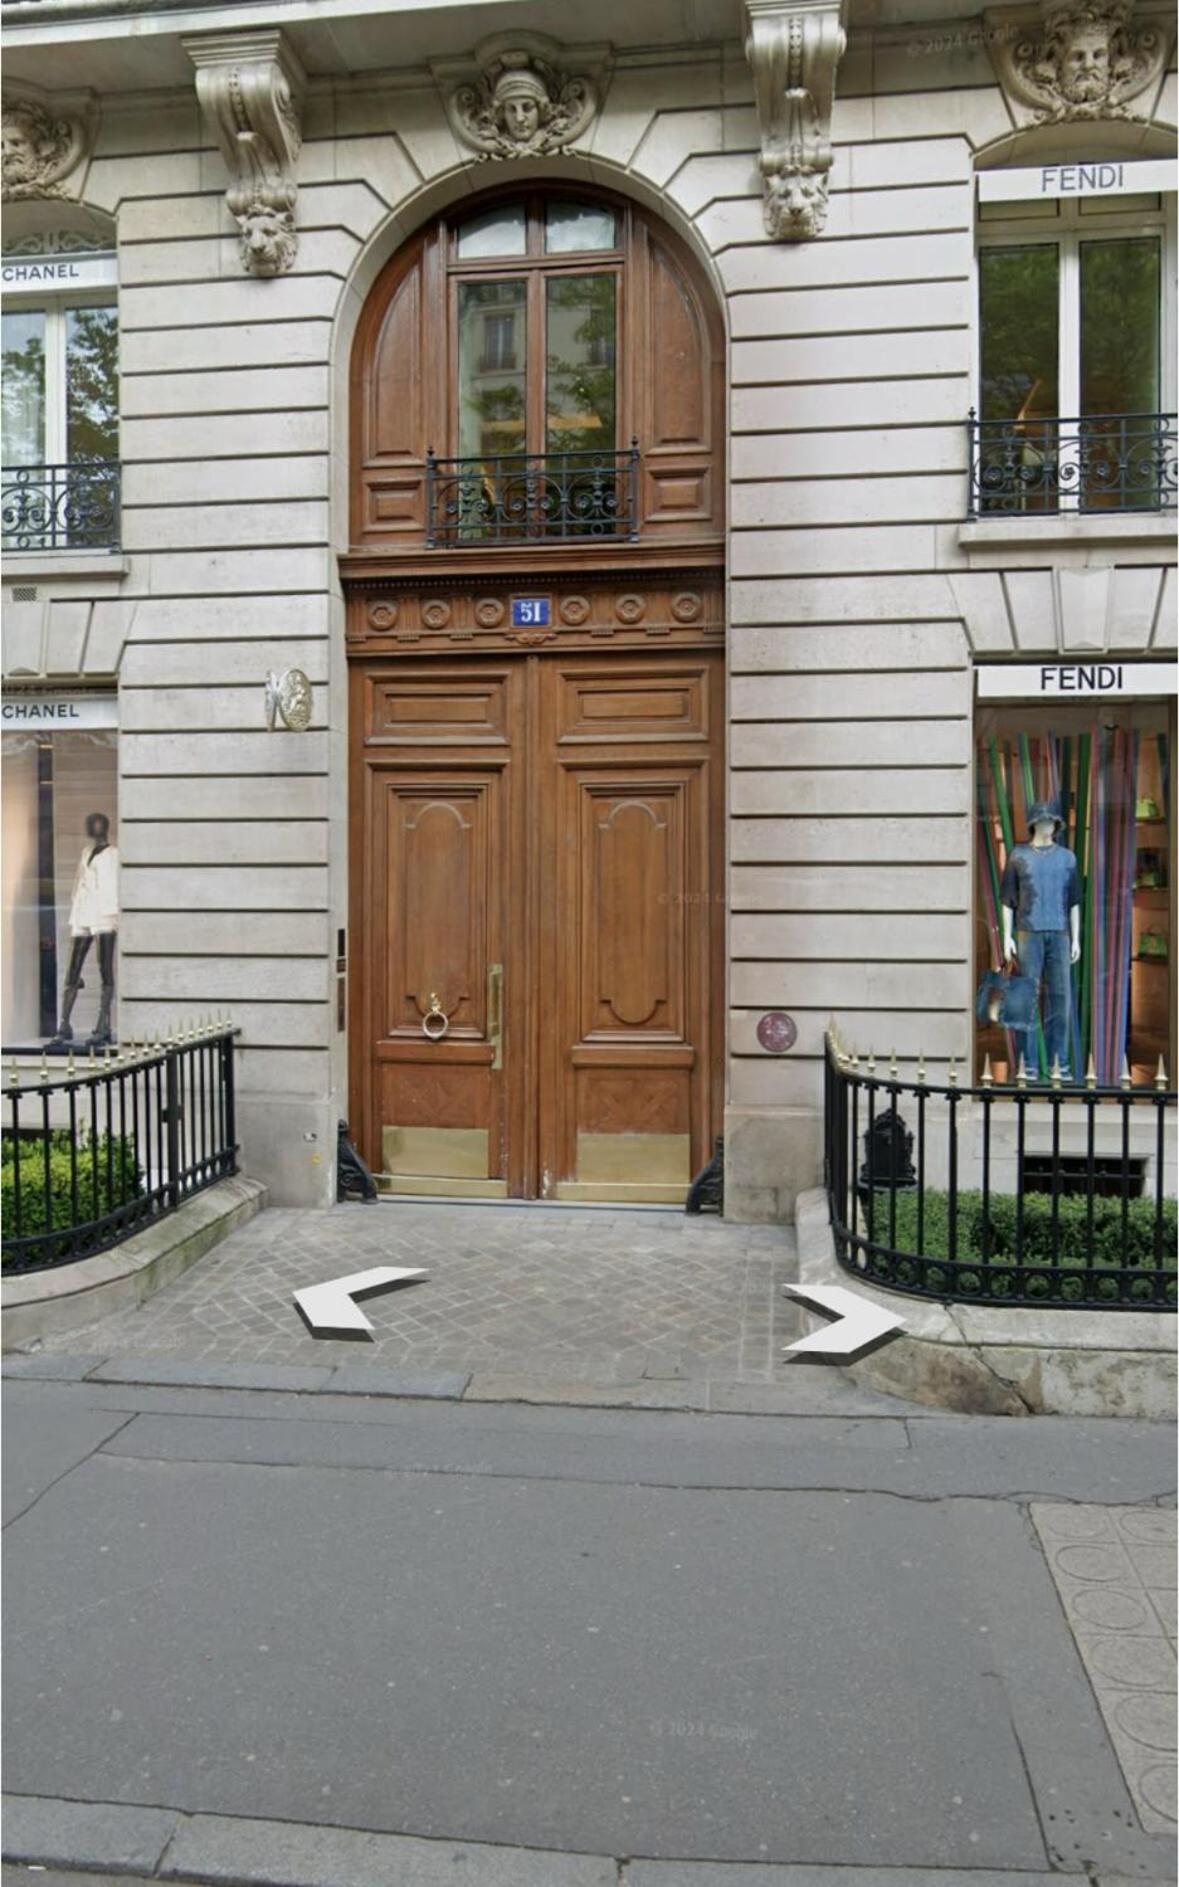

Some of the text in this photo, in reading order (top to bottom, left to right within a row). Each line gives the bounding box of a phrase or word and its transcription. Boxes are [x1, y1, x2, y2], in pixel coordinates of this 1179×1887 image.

[1042, 165, 1123, 192] FENDI
[2, 264, 79, 281] CHANEL
[520, 601, 541, 622] 51
[1041, 666, 1122, 690] FENDI
[2, 704, 79, 719] CHANEL
